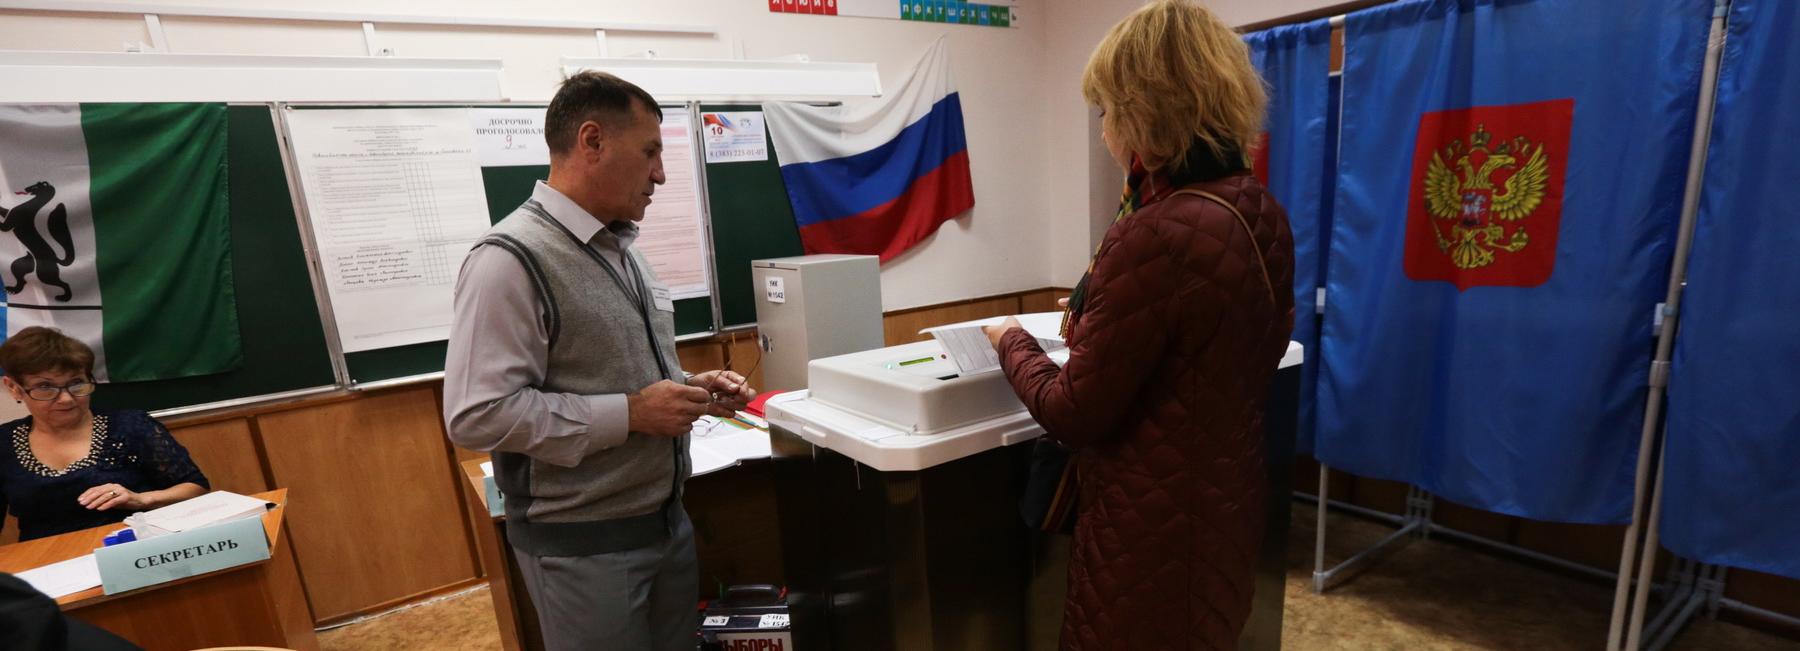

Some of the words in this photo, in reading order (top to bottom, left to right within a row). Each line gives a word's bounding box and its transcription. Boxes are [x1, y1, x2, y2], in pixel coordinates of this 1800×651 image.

[914, 4, 921, 15] ф
[712, 127, 723, 136] 10
[134, 539, 239, 569] СЕКРЕТАРЬ
